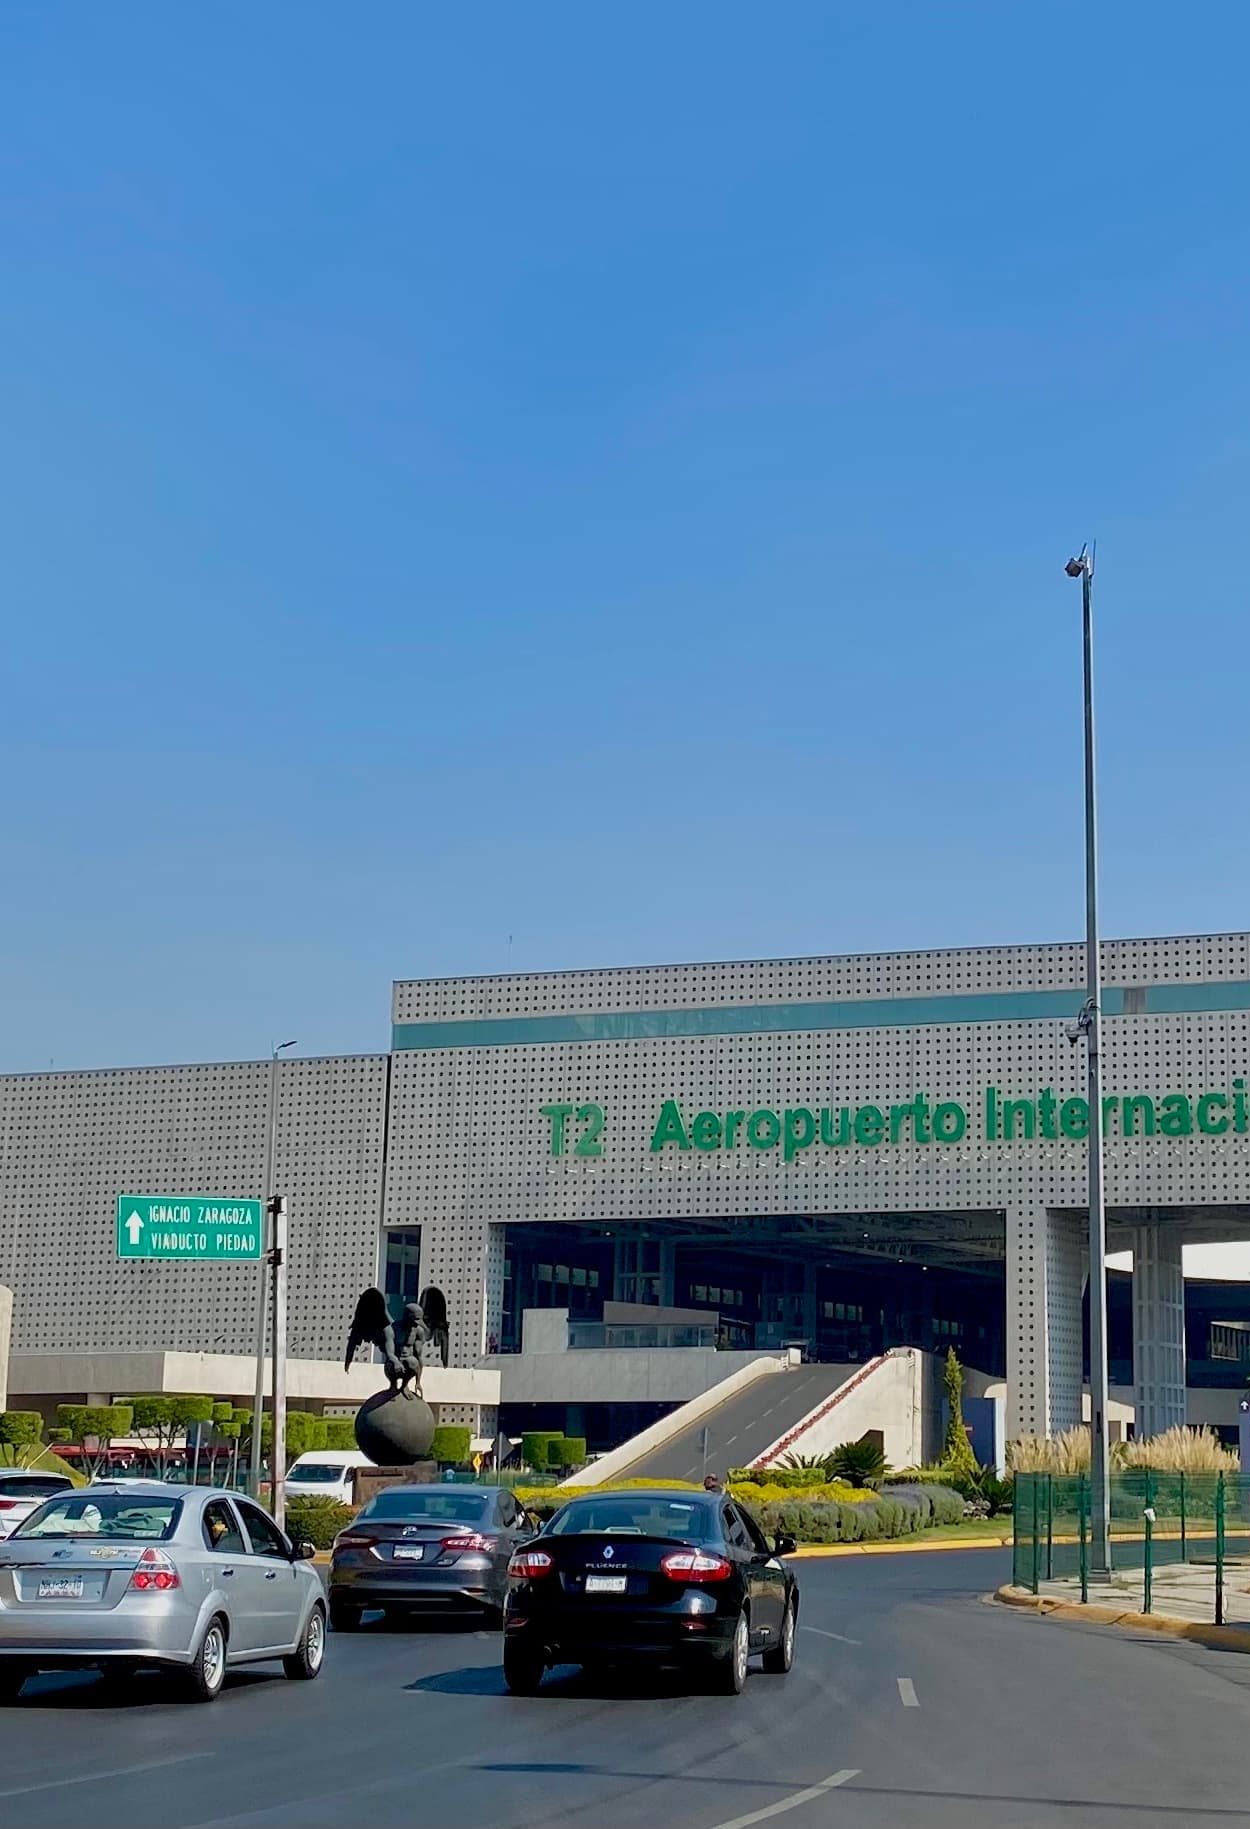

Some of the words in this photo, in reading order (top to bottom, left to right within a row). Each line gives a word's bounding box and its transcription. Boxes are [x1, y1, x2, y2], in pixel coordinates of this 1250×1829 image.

[542, 1103, 604, 1156] T2
[650, 1093, 967, 1162] Aeropuerto
[149, 1205, 190, 1222] IGNACIO
[198, 1207, 252, 1224] ZARAGOZA
[151, 1233, 206, 1249] VIADUCTO
[216, 1234, 255, 1251] PIEDAD
